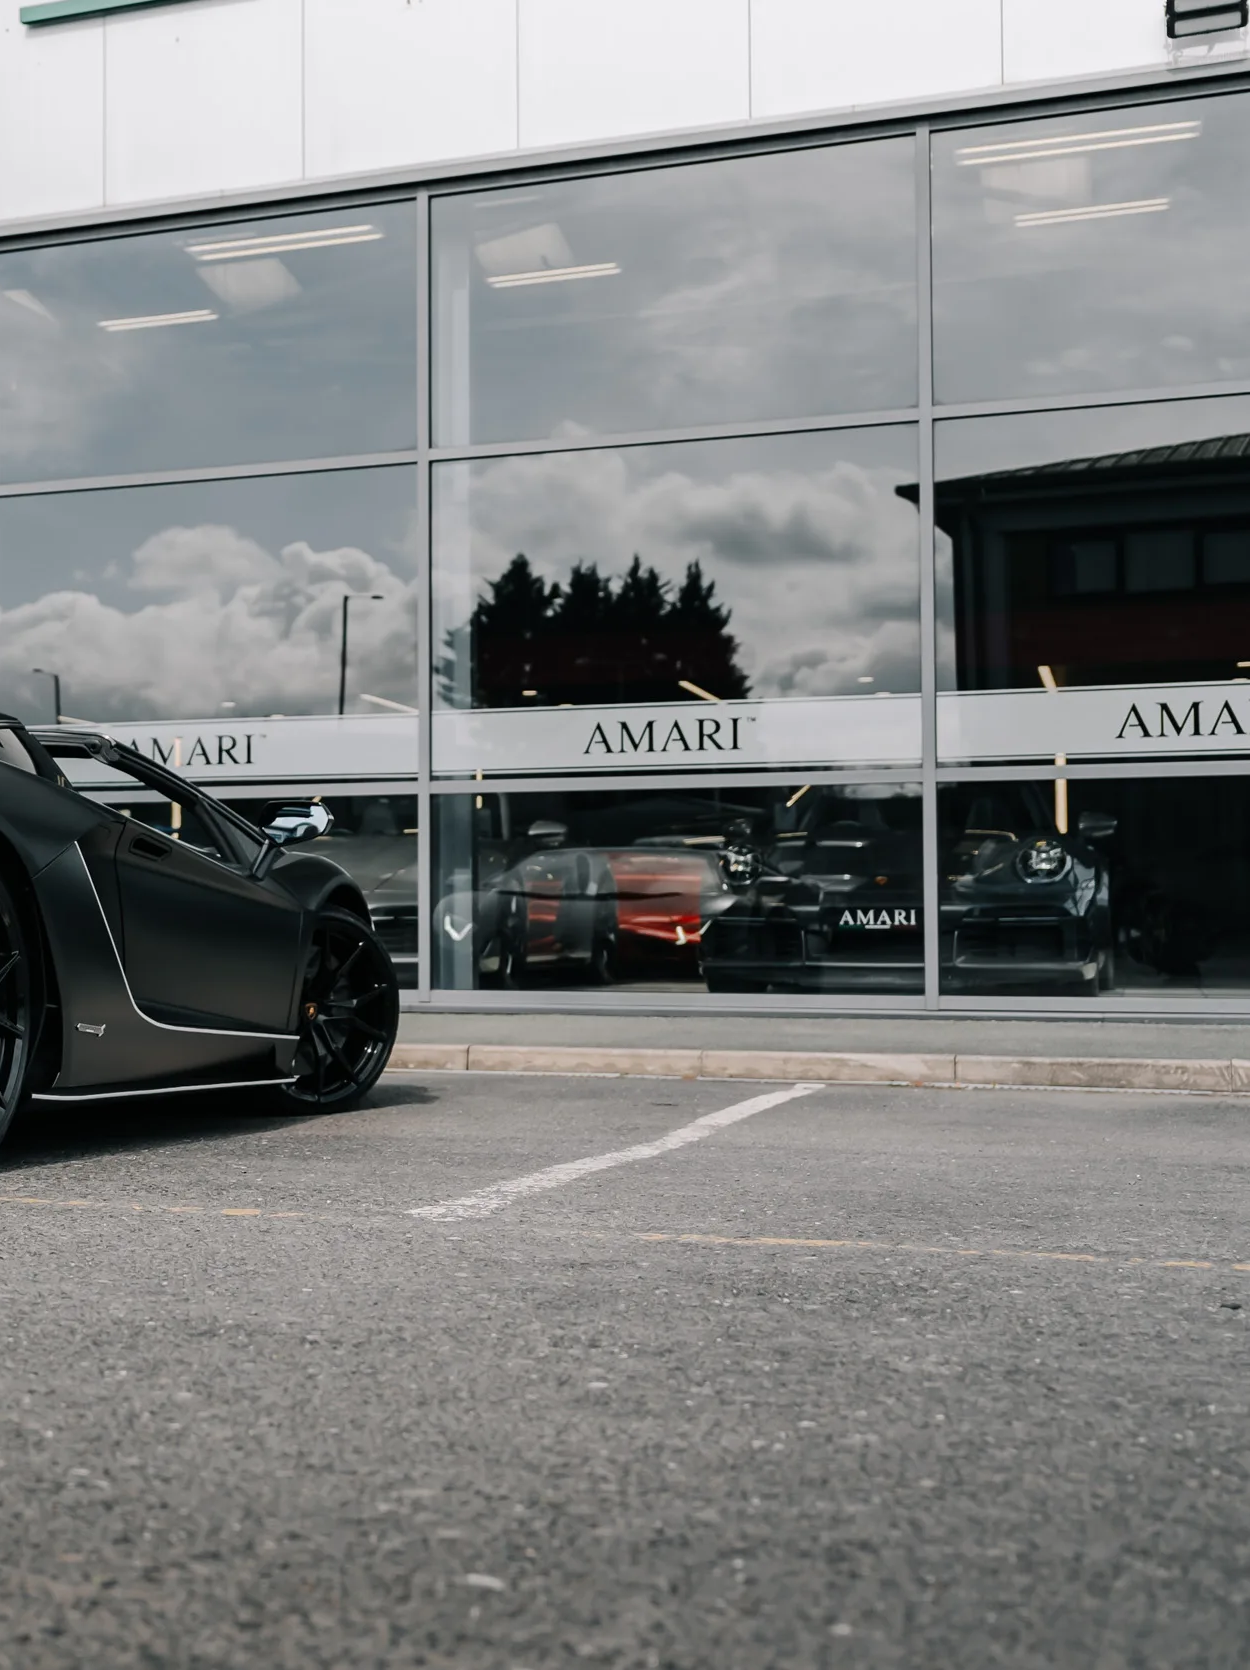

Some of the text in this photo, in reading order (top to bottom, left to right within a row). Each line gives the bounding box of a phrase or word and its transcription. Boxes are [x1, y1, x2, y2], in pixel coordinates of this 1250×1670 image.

[583, 716, 743, 754] AMARI
[1115, 699, 1250, 739] AMA
[838, 908, 917, 926] AMARI
